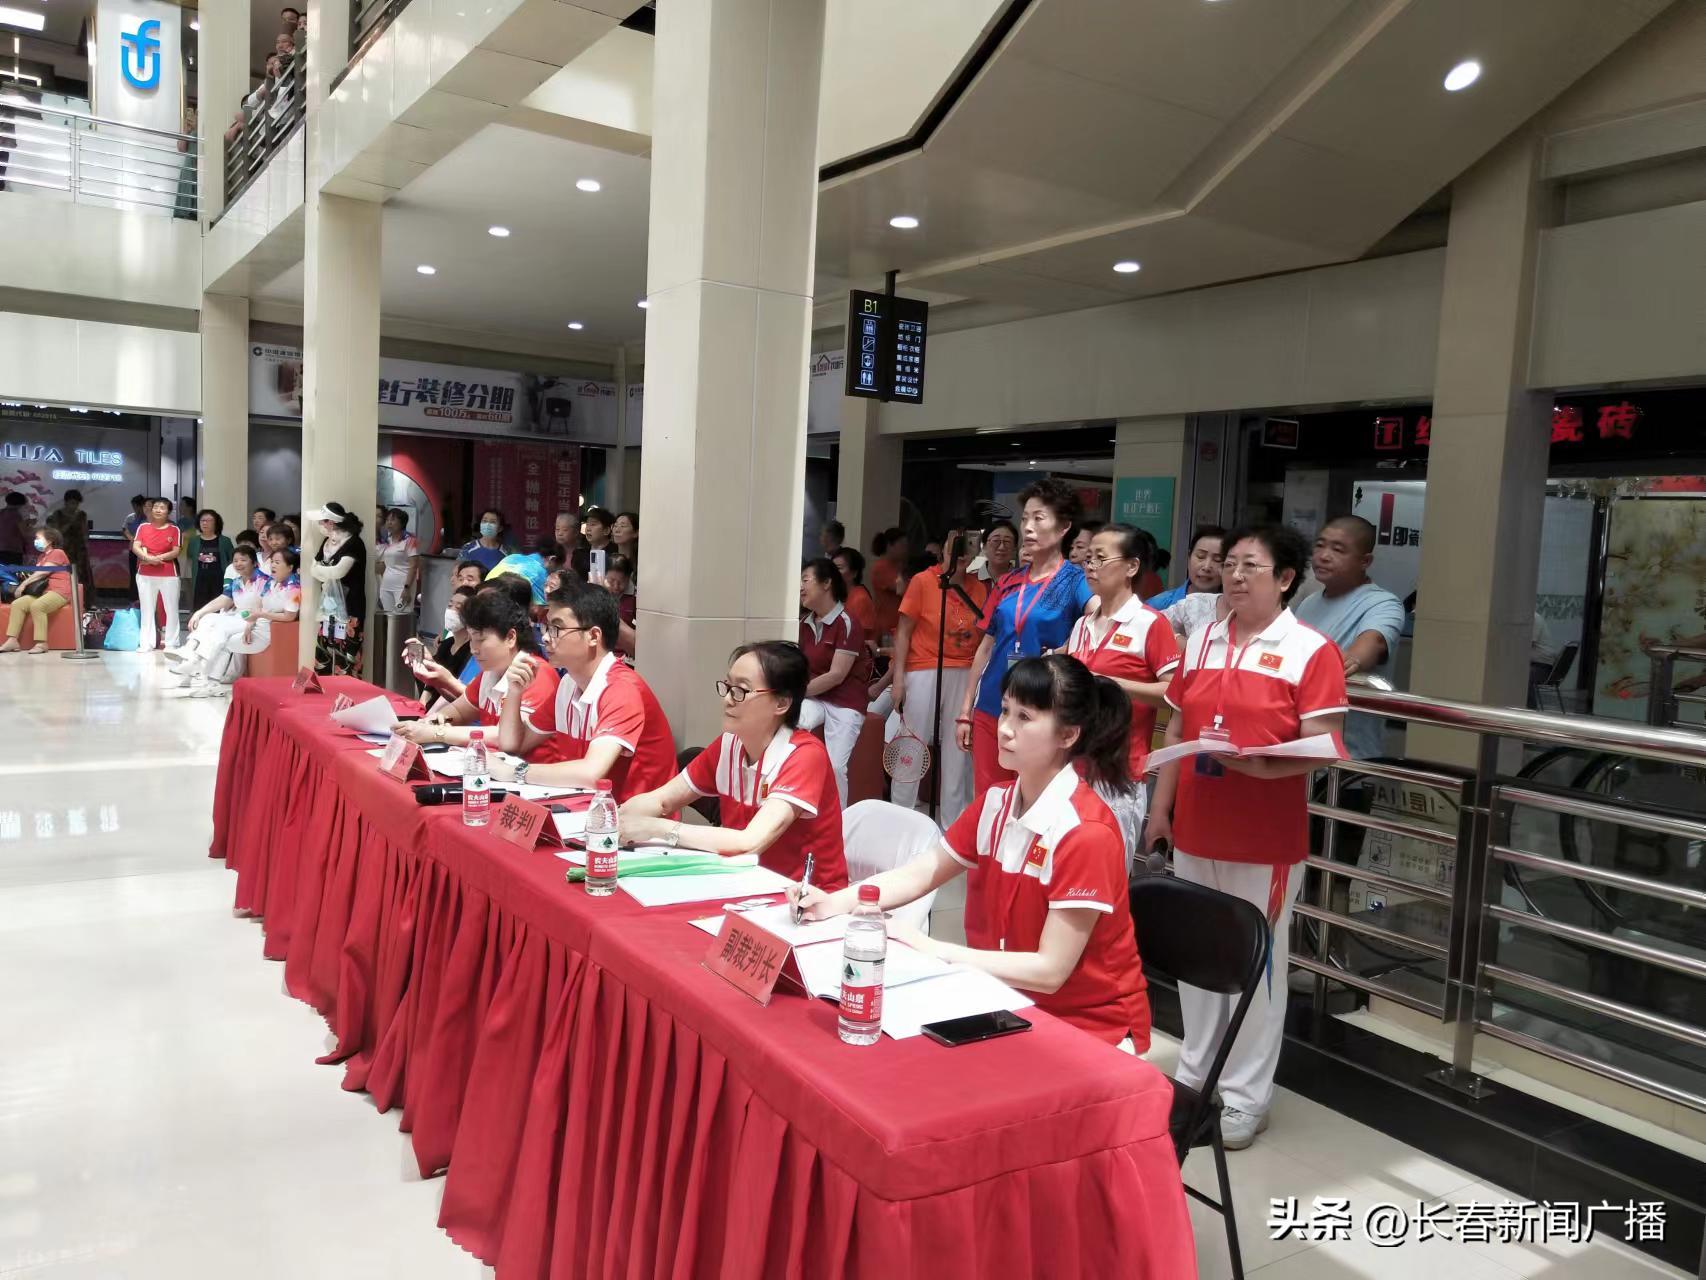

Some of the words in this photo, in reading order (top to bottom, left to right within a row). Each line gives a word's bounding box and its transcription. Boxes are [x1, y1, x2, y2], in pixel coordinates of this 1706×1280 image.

[864, 299, 878, 313] B1
[0, 443, 64, 463] LISA
[74, 448, 124, 467] TILES
[500, 803, 537, 837] 裁判
[720, 928, 778, 984] 副裁判长
[841, 989, 865, 1004] 夫山泉
